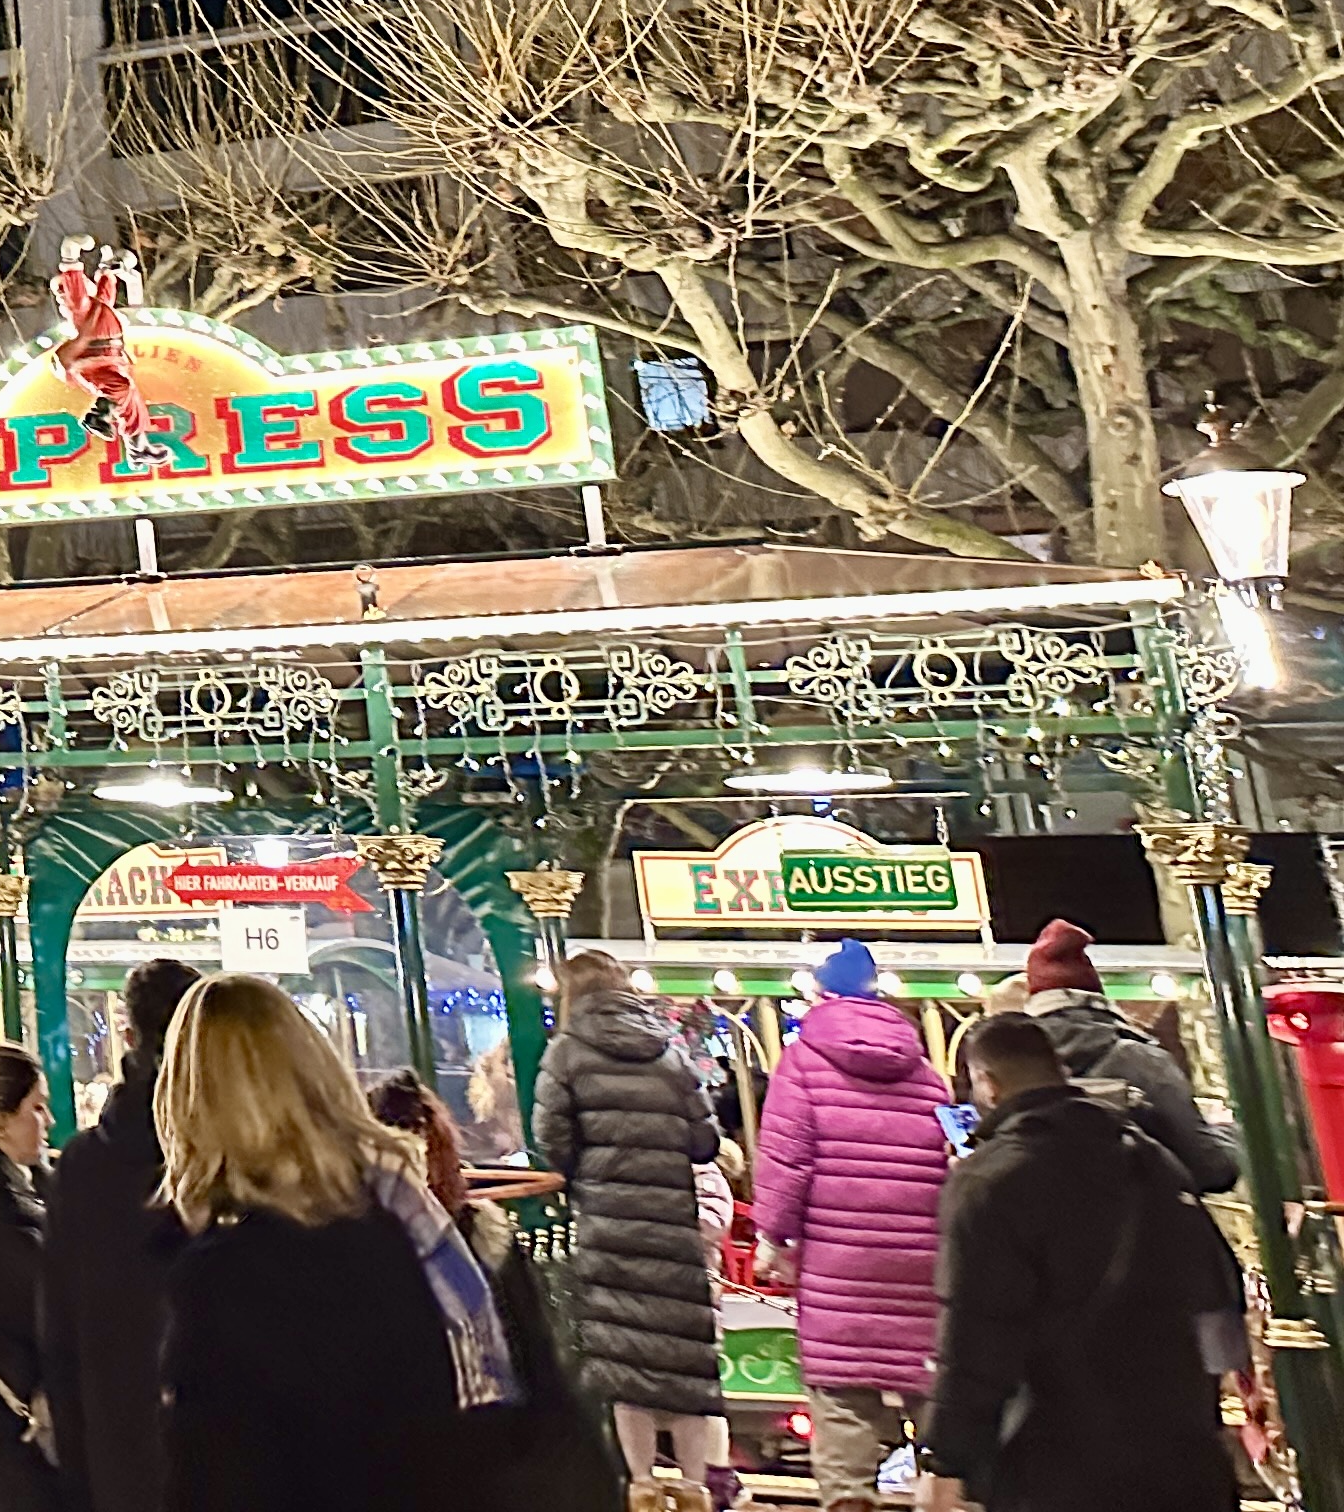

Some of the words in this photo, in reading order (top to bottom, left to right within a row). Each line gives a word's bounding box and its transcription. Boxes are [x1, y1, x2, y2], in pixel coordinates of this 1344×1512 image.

[174, 875, 201, 889] HIER
[204, 873, 339, 892] FAHRKARTEN-VERKAUF
[789, 864, 951, 895] AUSSTIEG
[245, 928, 279, 950] H6
